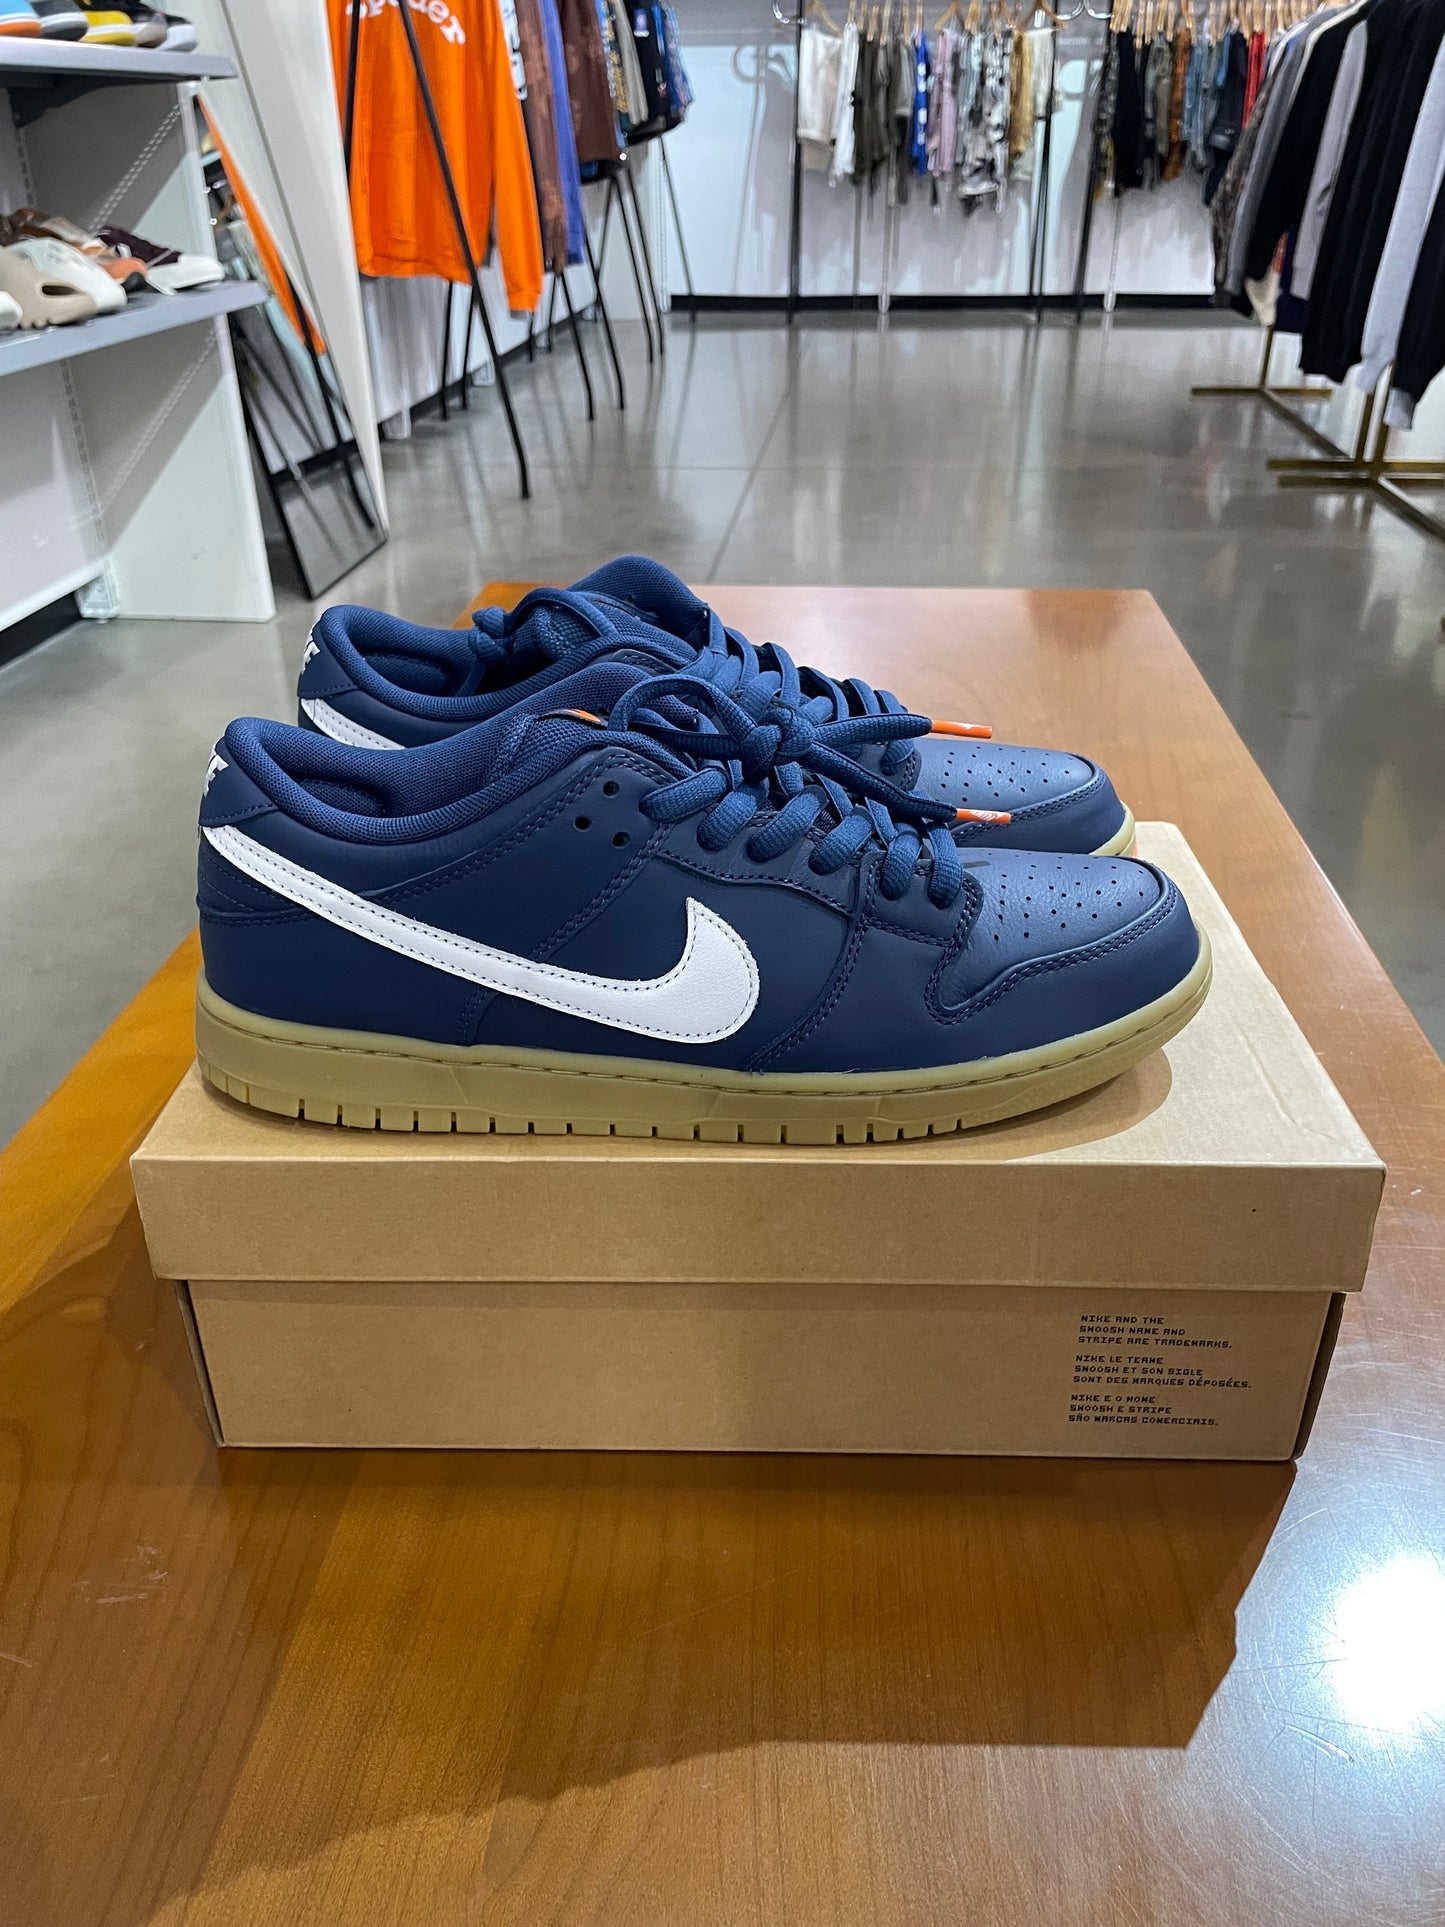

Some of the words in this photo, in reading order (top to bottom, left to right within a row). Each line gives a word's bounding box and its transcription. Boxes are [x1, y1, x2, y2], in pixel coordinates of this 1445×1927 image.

[1126, 1337, 1150, 1345] ARE
[1154, 1338, 1232, 1348] TRADEMARKS.
[1127, 1356, 1164, 1364] TERME
[1132, 1377, 1184, 1386] MARQUES
[1188, 1377, 1252, 1388] DÉPOSÉES.
[1068, 1413, 1090, 1422] SÃO
[1142, 1416, 1219, 1426] COMERCIAIS.
